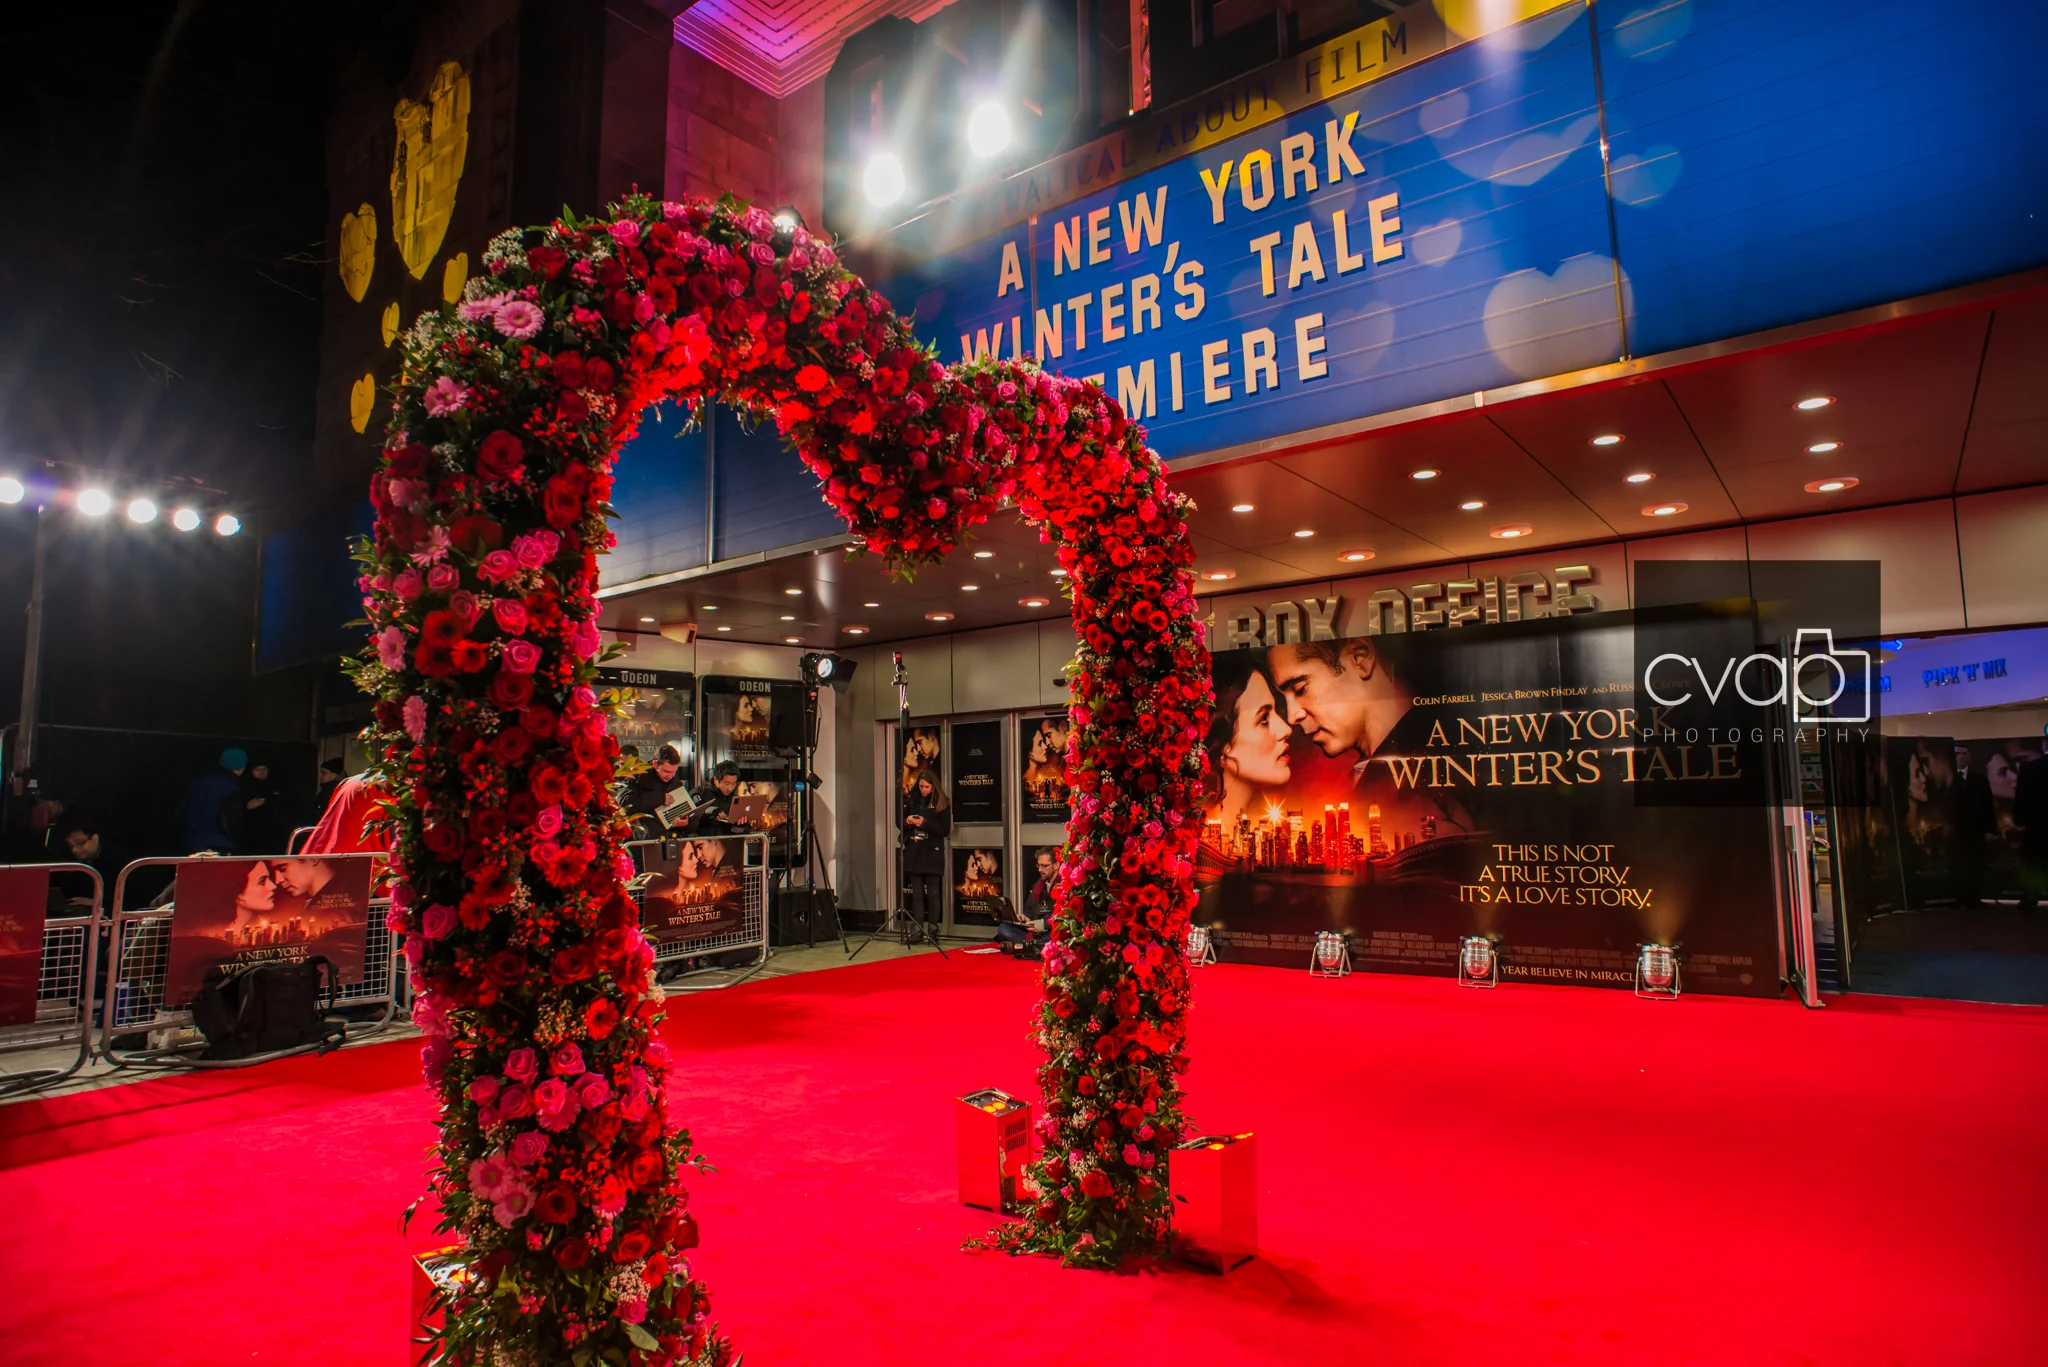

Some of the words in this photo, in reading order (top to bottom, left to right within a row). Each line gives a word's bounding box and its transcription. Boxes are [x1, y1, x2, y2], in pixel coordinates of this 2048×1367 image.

[1156, 76, 1273, 154] ABOUT
[1304, 21, 1408, 94] FILM
[997, 240, 1024, 297] A
[1053, 184, 1169, 277] NEW
[1200, 110, 1368, 225] YORK
[960, 240, 1206, 364] WINTER'S
[1249, 191, 1404, 297] TALE
[1082, 312, 1329, 421] MIERE
[621, 671, 657, 685] ODEON
[1922, 666, 1961, 688] PICK
[1982, 658, 2008, 679] MIX
[739, 680, 771, 693] ODEON
[1412, 696, 1441, 707] COLIN
[1441, 694, 1476, 706] FARRELL
[1481, 691, 1513, 703] JESSICA
[1514, 688, 1549, 701] BROWN
[1550, 685, 1588, 698] FINDLAY
[1426, 719, 1450, 747] A
[1457, 712, 1552, 746] NEW
[1559, 705, 1681, 743] YORK
[1383, 748, 1601, 790] WINTER'S
[1611, 743, 1743, 783] TALE
[1492, 844, 1539, 862] THIS
[1544, 844, 1559, 862] IS
[1563, 844, 1615, 863] NOT
[1478, 864, 1496, 882] A
[1496, 865, 1551, 883] TRUE
[1554, 865, 1631, 887] STORY.
[1459, 885, 1491, 903] IT'S
[1494, 886, 1512, 903] A
[1516, 886, 1571, 905] LOVE
[1575, 888, 1653, 910] STORY.
[668, 913, 704, 926] WINTER'S
[704, 911, 721, 921] TALE
[682, 907, 697, 916] NEW
[697, 904, 715, 914] YORK
[235, 952, 243, 961] A
[245, 949, 275, 961] NEW
[276, 945, 308, 957] YORK
[1501, 965, 1528, 976] YEAR
[1530, 966, 1573, 979] BELIEVE
[1575, 969, 1588, 979] IN
